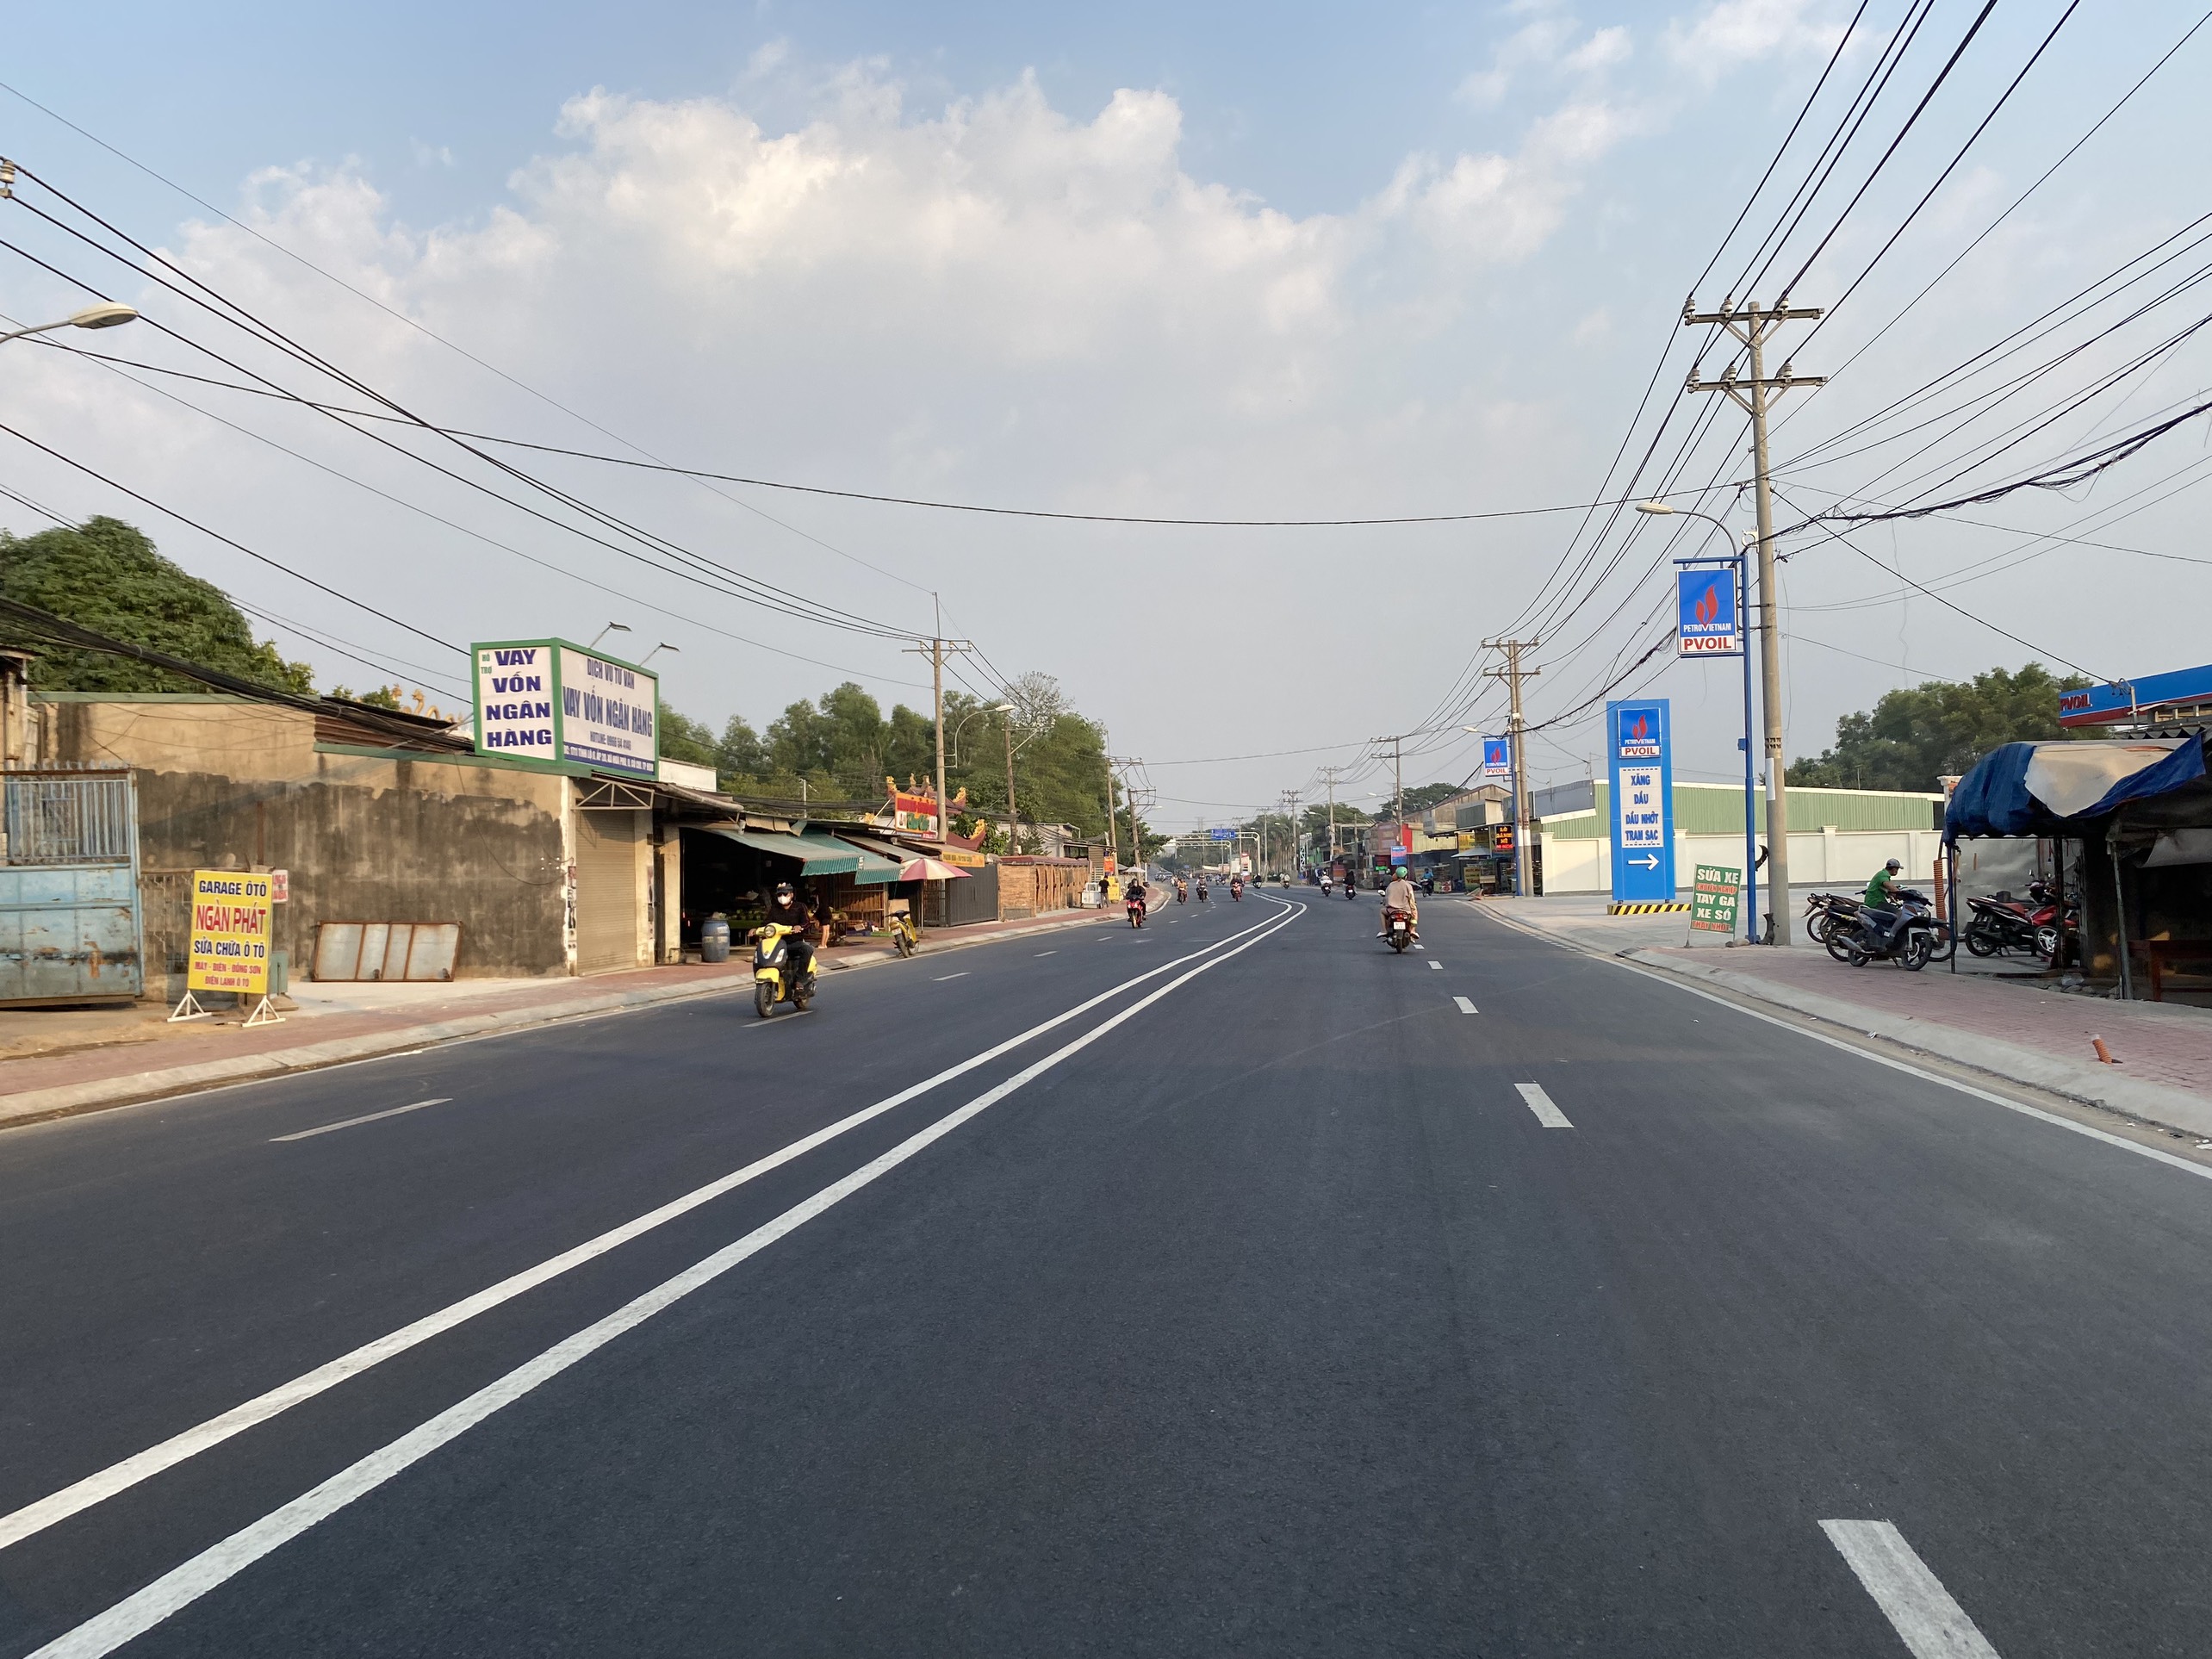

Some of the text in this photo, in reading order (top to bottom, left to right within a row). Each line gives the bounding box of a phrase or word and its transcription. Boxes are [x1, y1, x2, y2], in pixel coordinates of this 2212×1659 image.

[1683, 623, 1731, 632] PETROVIETNAM
[1683, 637, 1732, 650] PVOIL
[494, 649, 537, 666] VAY
[492, 671, 541, 693] VỐN
[486, 700, 550, 720] NGÂN
[2060, 693, 2093, 711] PVOIL
[562, 685, 652, 738] VAY VỐN NGÂN HÀNG
[487, 729, 552, 747] HÀNG
[1625, 747, 1656, 755] PVOIL
[1631, 774, 1650, 786] XĂNG
[1697, 867, 1739, 884] SỬA XE
[199, 880, 242, 895] GARAGE
[1695, 892, 1736, 907] TAY GA
[196, 899, 266, 935] NGÀN PHÁT
[1696, 907, 1731, 921] XE SỐ
[1692, 921, 1709, 929] THAY
[194, 936, 264, 958] SỬA CHỮA Ô TÔ
